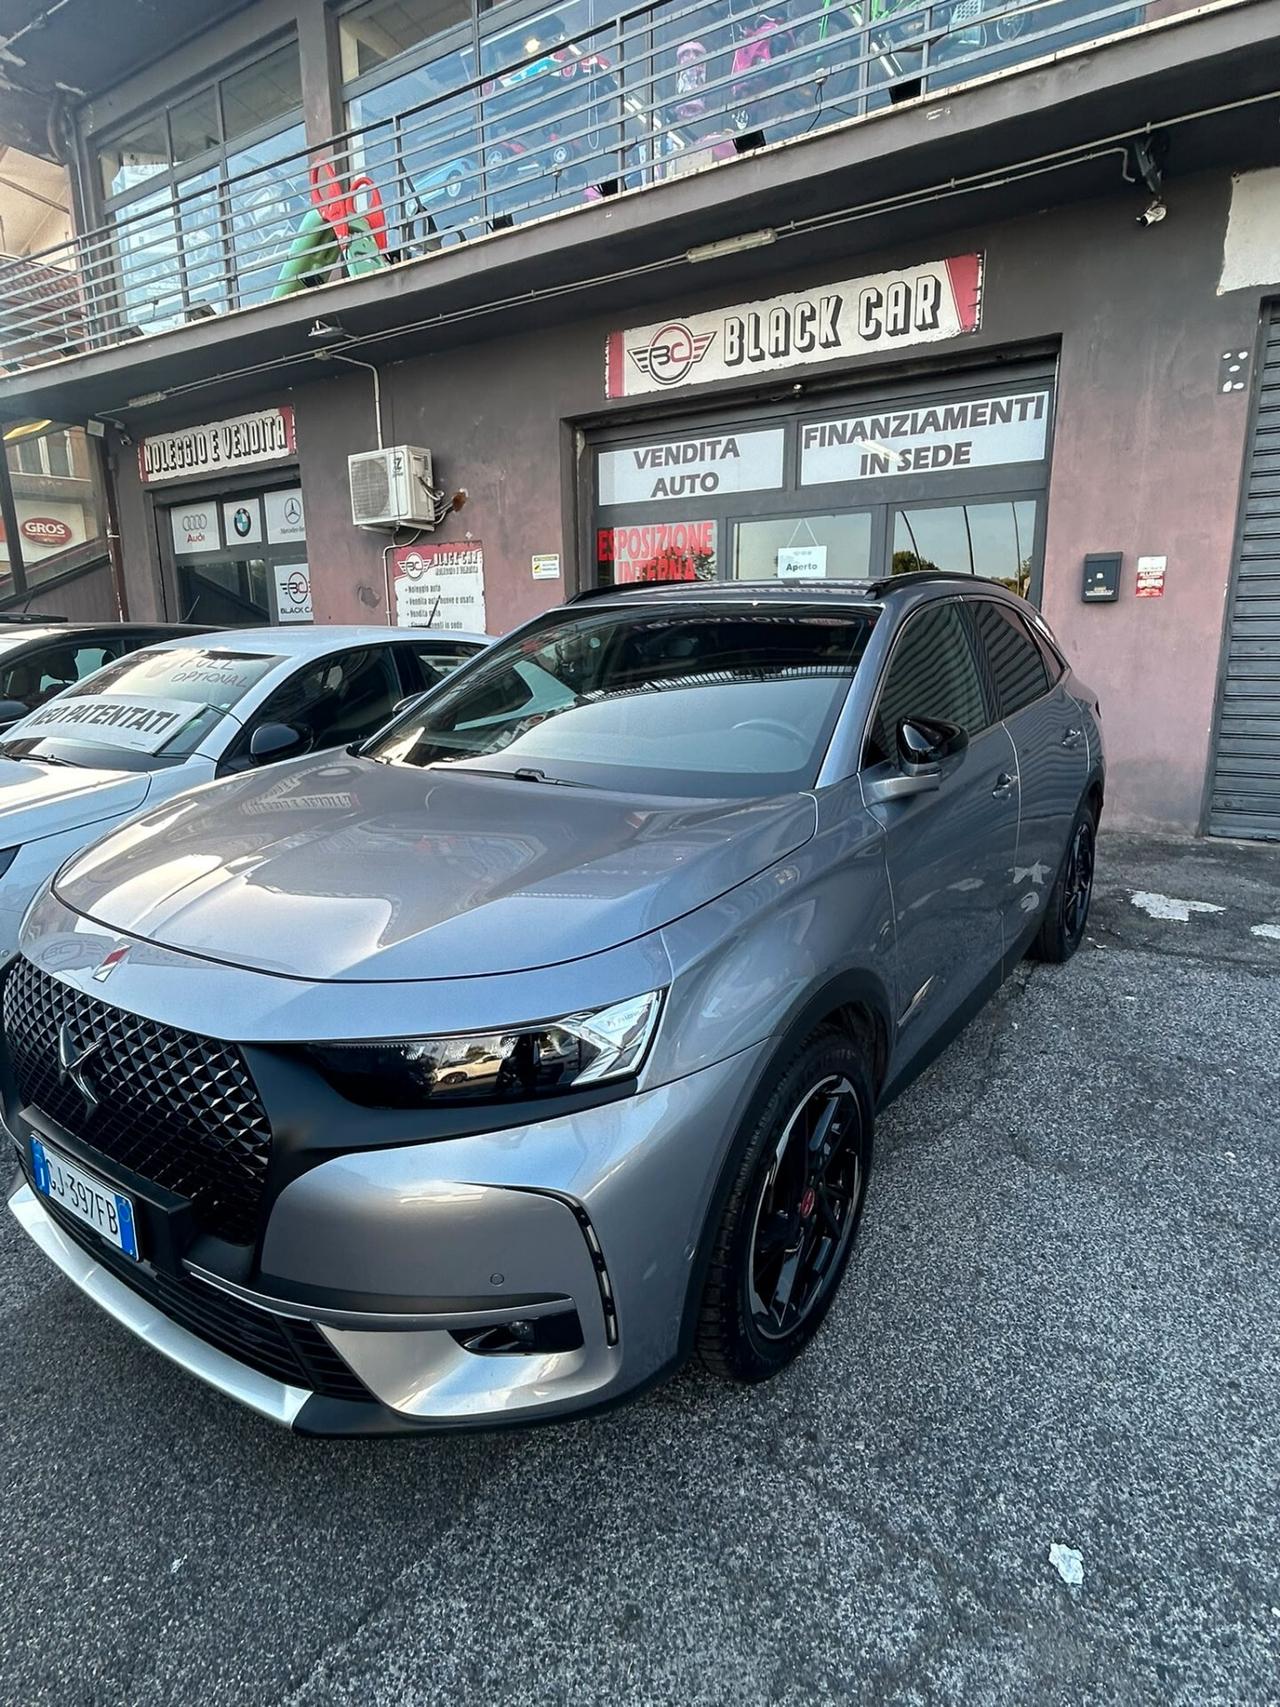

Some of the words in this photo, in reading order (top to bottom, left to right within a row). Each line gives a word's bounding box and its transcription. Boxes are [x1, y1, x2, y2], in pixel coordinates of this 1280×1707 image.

[723, 294, 843, 367] BLACK
[858, 274, 941, 341] CAR
[804, 395, 1045, 449] FINANZIAMENTI
[143, 432, 208, 474] NOLEGGIO
[209, 429, 221, 462] E
[222, 415, 288, 459] VENDITA
[634, 437, 740, 470] VENDITA
[860, 453, 890, 476] IN
[897, 441, 973, 472] SEDE
[650, 472, 719, 498] AUTO
[25, 521, 66, 535] GROS
[187, 532, 206, 543] Audi
[597, 522, 714, 562] ESPOSIZIONE
[617, 555, 697, 584] INTERNA
[786, 562, 818, 572] Aperto
[280, 607, 303, 615] BLACK
[179, 655, 234, 671] FULL
[170, 670, 248, 688] OPTIONAL
[65, 703, 181, 735] PATENTATI
